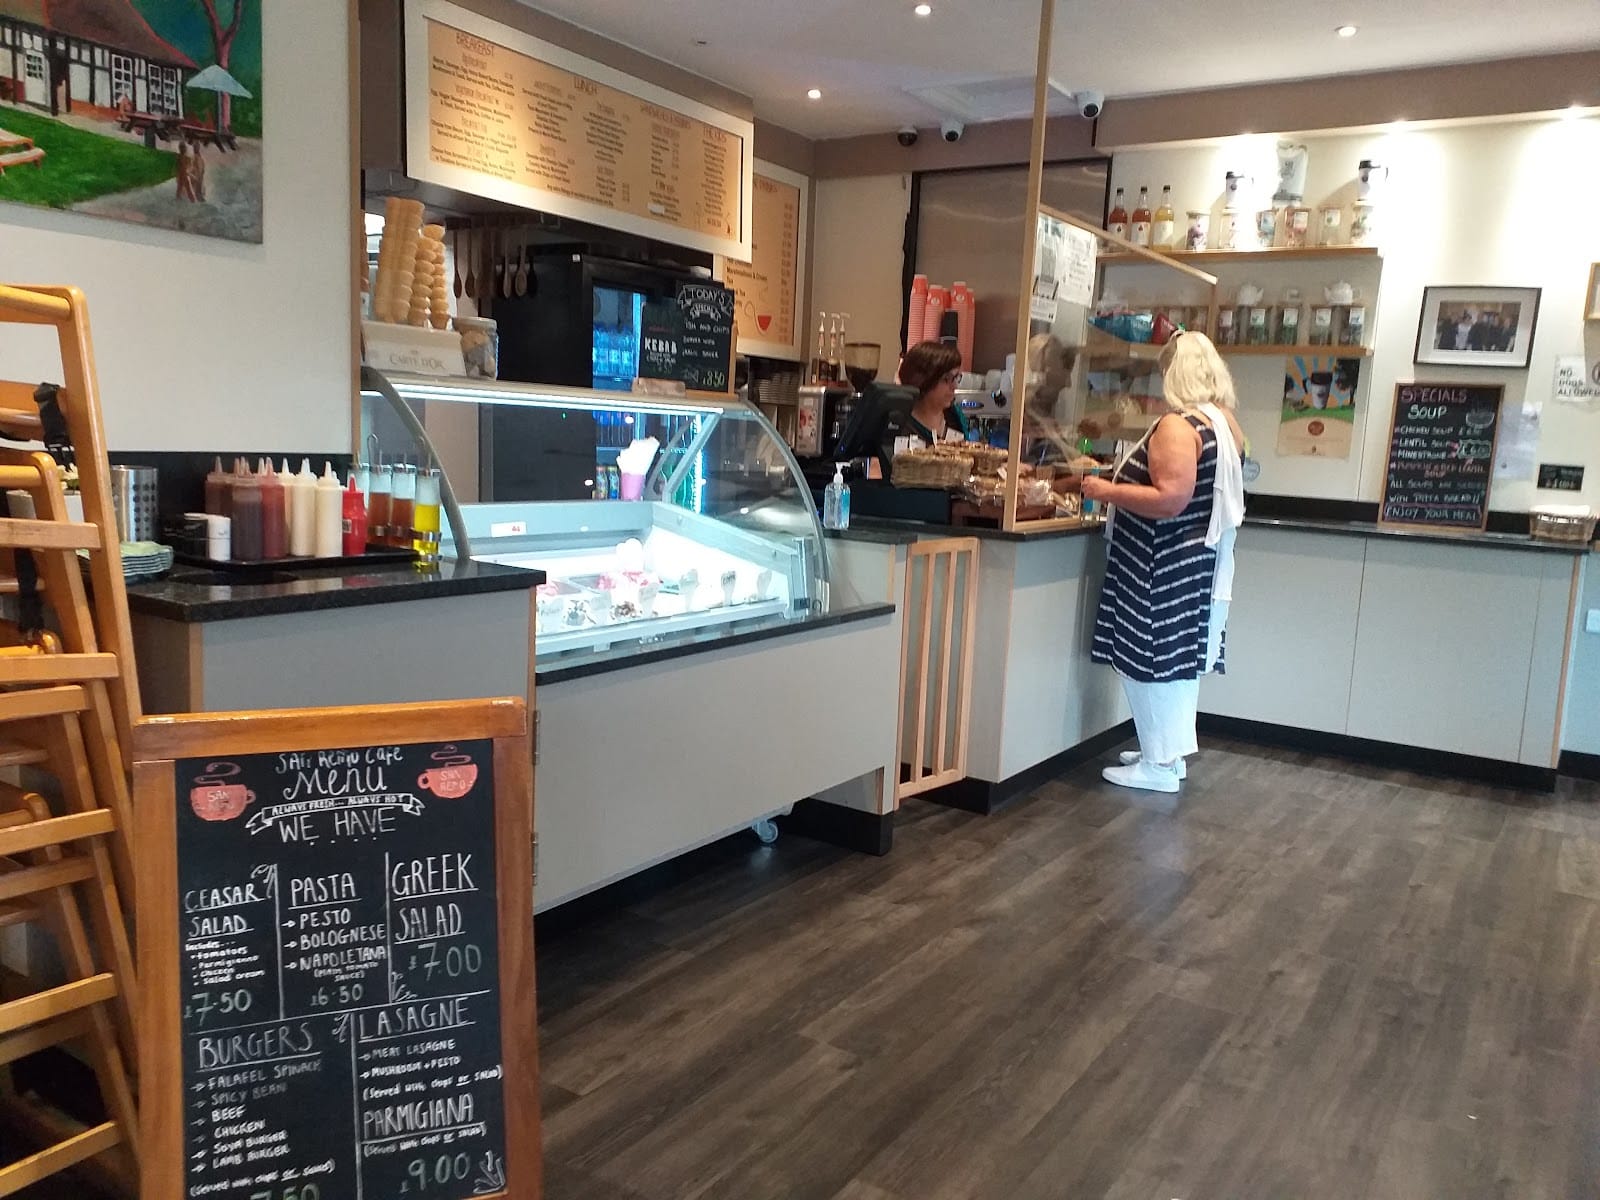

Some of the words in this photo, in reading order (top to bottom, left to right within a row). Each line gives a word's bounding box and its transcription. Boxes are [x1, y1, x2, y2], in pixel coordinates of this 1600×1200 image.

[644, 336, 678, 355] KEBAB
[1400, 387, 1468, 404] SPECIALS
[1407, 404, 1448, 420] SOUP
[283, 766, 388, 800] Menu
[271, 801, 307, 817] ALWAYS
[278, 815, 320, 843] WE
[334, 806, 397, 836] HAVE
[391, 852, 475, 896] GREEK
[185, 883, 259, 912] CEASAR
[290, 872, 356, 907] PASTA
[188, 914, 248, 938] SALAD
[300, 908, 351, 930] PESTO
[395, 902, 463, 942] SALAD
[299, 923, 386, 951] BOLOGNESE
[299, 945, 387, 971] NAPOLETANA
[359, 997, 469, 1040] LASAGNE
[198, 1022, 313, 1069] BURGERS
[371, 1046, 400, 1059] MEAT
[406, 1038, 457, 1055] LASAGNE
[207, 1068, 267, 1091] FALAFEL
[273, 1059, 323, 1079] SPINACH
[371, 1060, 421, 1077] MUSHROOM
[211, 1090, 248, 1106] SPICY
[252, 1083, 288, 1100] BEAN
[211, 1104, 247, 1123] BEEF
[362, 1092, 474, 1139] PARMIGIANA
[213, 1118, 266, 1139] CHICKEN
[245, 1129, 289, 1148] BURGER
[212, 1152, 244, 1169] LAMB
[247, 1143, 291, 1161] BURGER
